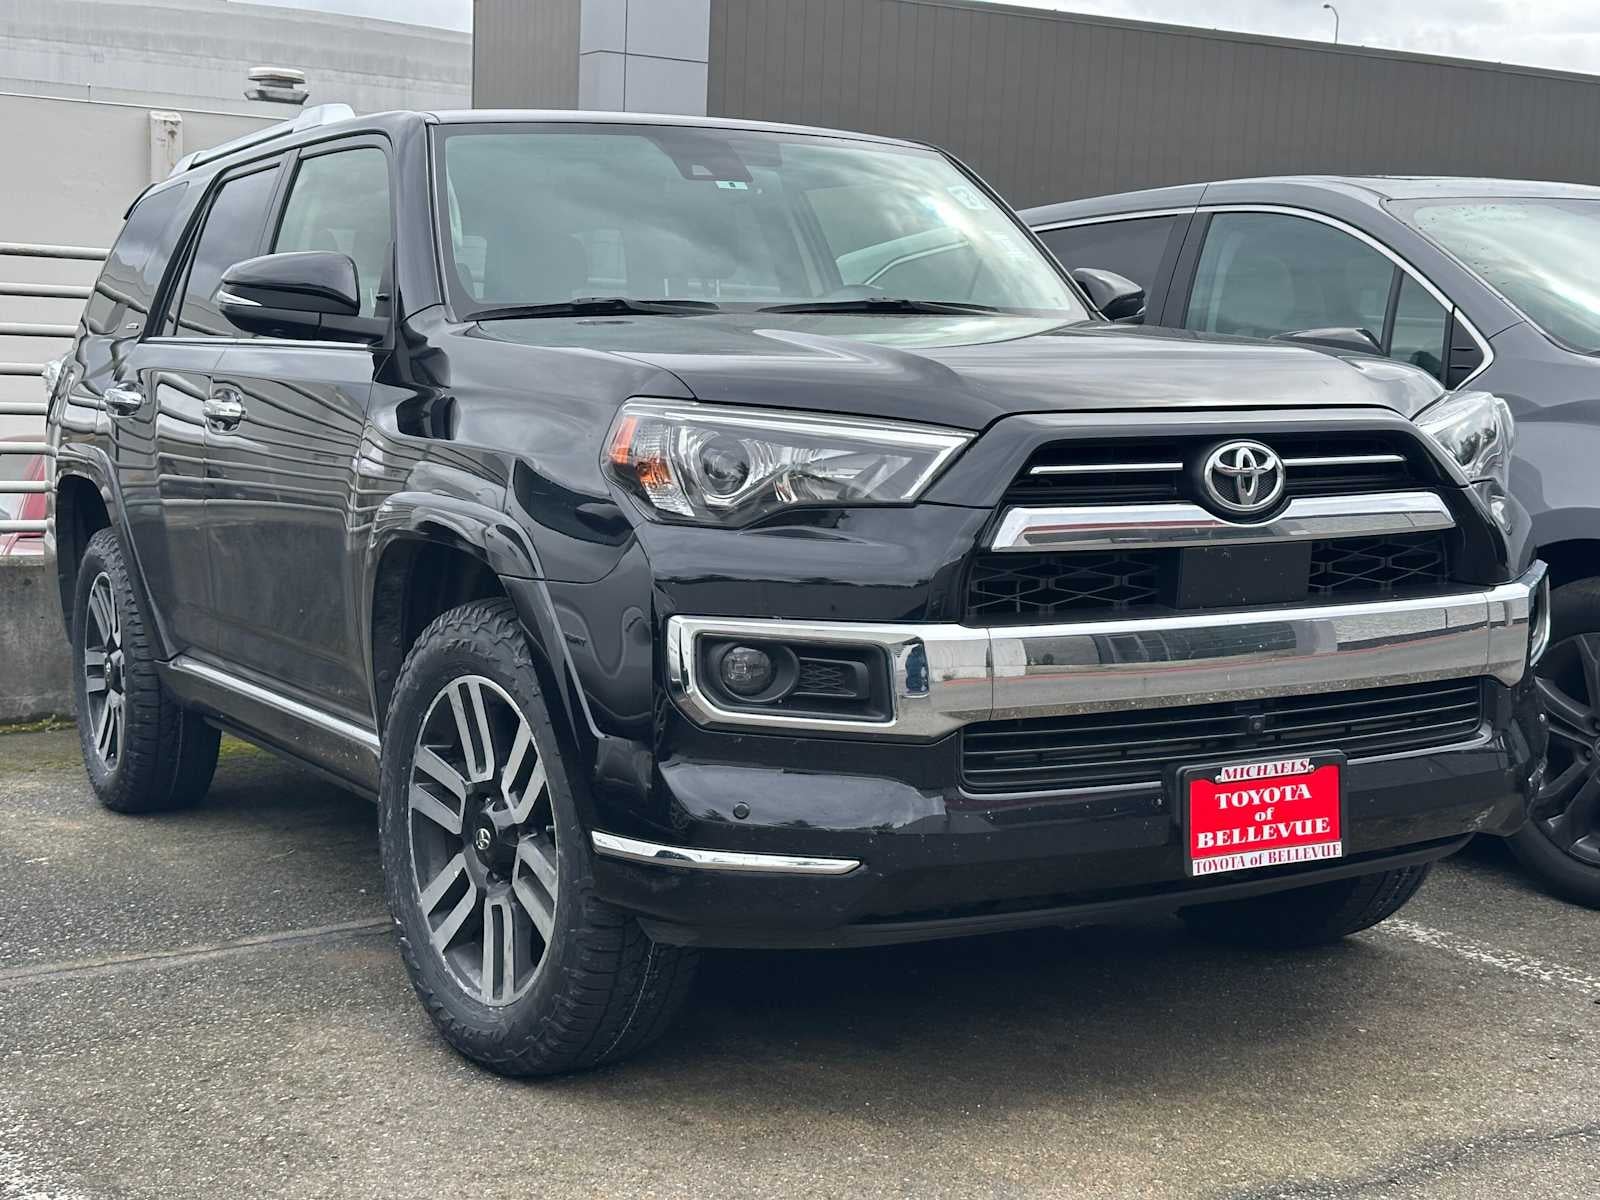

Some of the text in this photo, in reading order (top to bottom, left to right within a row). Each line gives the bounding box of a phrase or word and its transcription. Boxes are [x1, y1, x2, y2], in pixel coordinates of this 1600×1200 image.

[1223, 760, 1309, 780] MICHAELS
[1215, 783, 1312, 809] TOYOTA
[1254, 807, 1275, 822] of
[1197, 817, 1330, 849] BELLEVUE
[1194, 843, 1341, 874] TOYOTA of BELLEVUE
